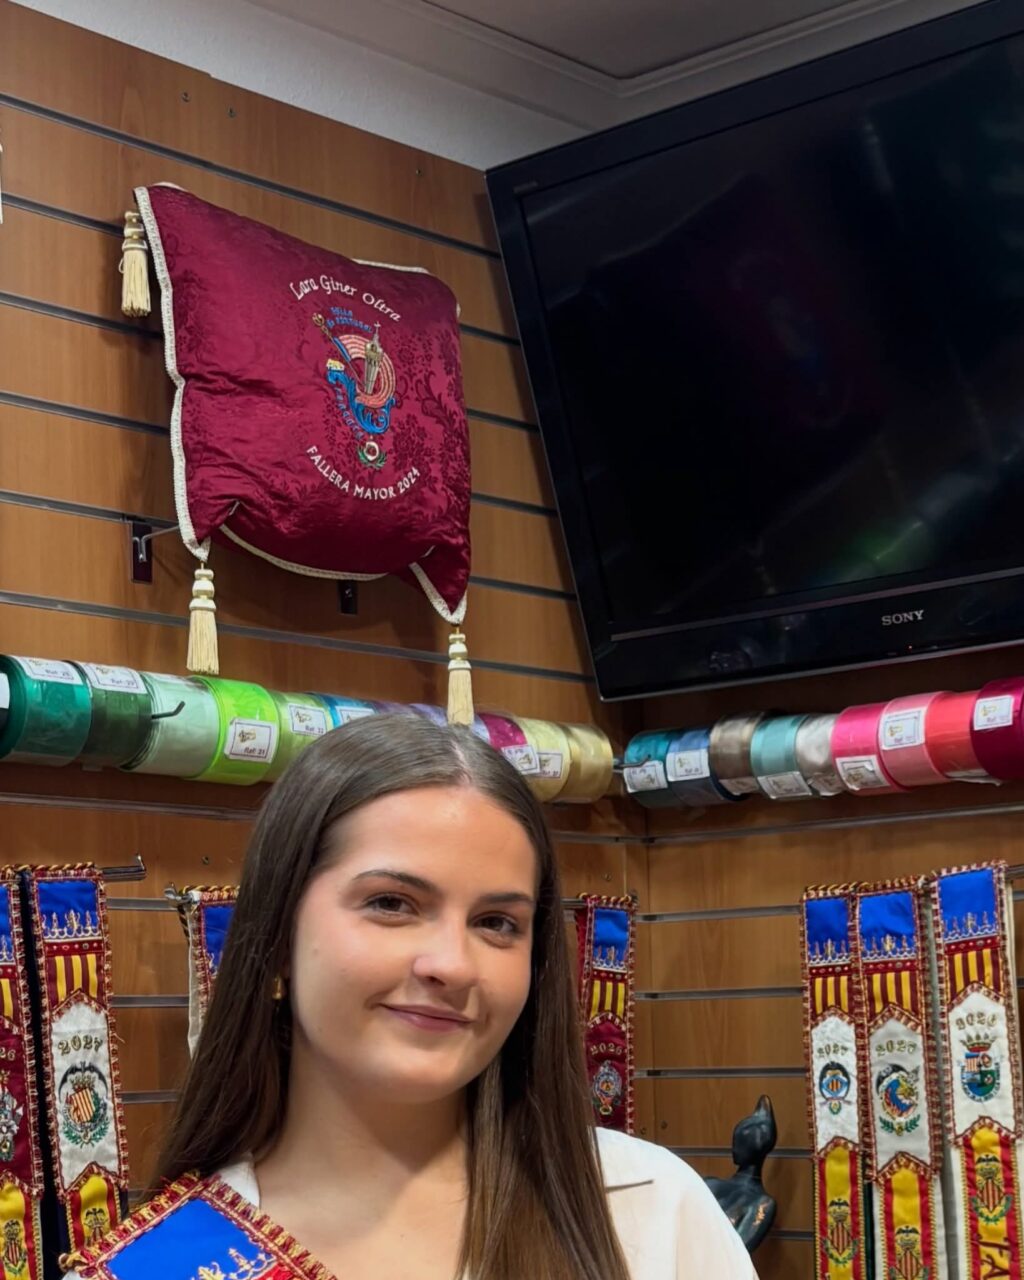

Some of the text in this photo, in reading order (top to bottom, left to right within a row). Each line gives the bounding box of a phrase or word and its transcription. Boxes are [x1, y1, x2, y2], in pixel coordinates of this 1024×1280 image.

[289, 274, 402, 323] Lara Giner Oltra
[306, 445, 422, 501] FALLERA MAYOR 2024
[881, 610, 925, 626] SONY
[58, 1034, 103, 1056] 2027
